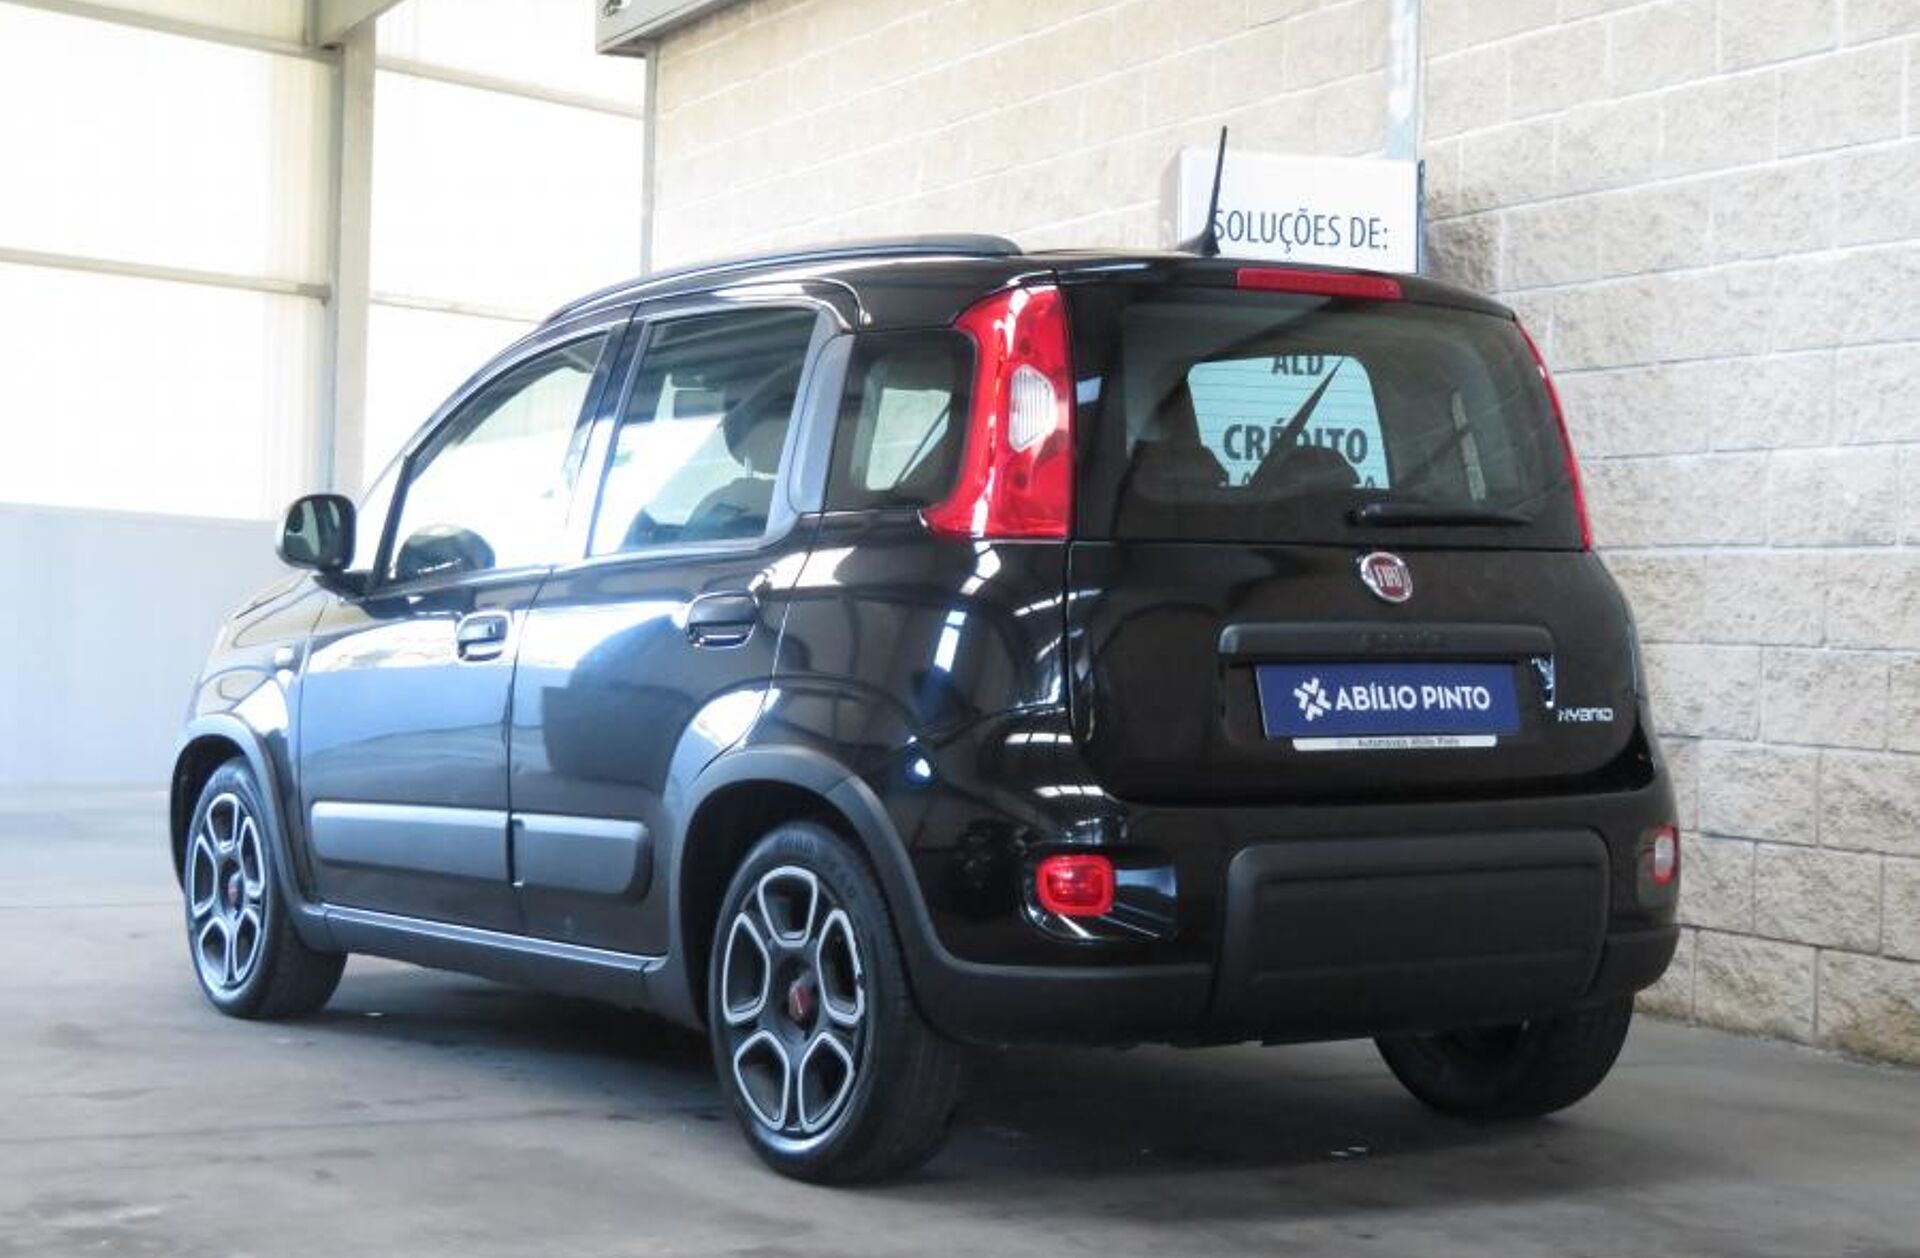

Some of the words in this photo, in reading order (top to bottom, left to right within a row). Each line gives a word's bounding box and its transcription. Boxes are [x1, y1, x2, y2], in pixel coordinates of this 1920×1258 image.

[1213, 208, 1341, 254] SOLUÇÕES
[1350, 216, 1390, 250] DE:
[1335, 682, 1417, 711] ABÍLIO
[1421, 685, 1490, 711] PINTO
